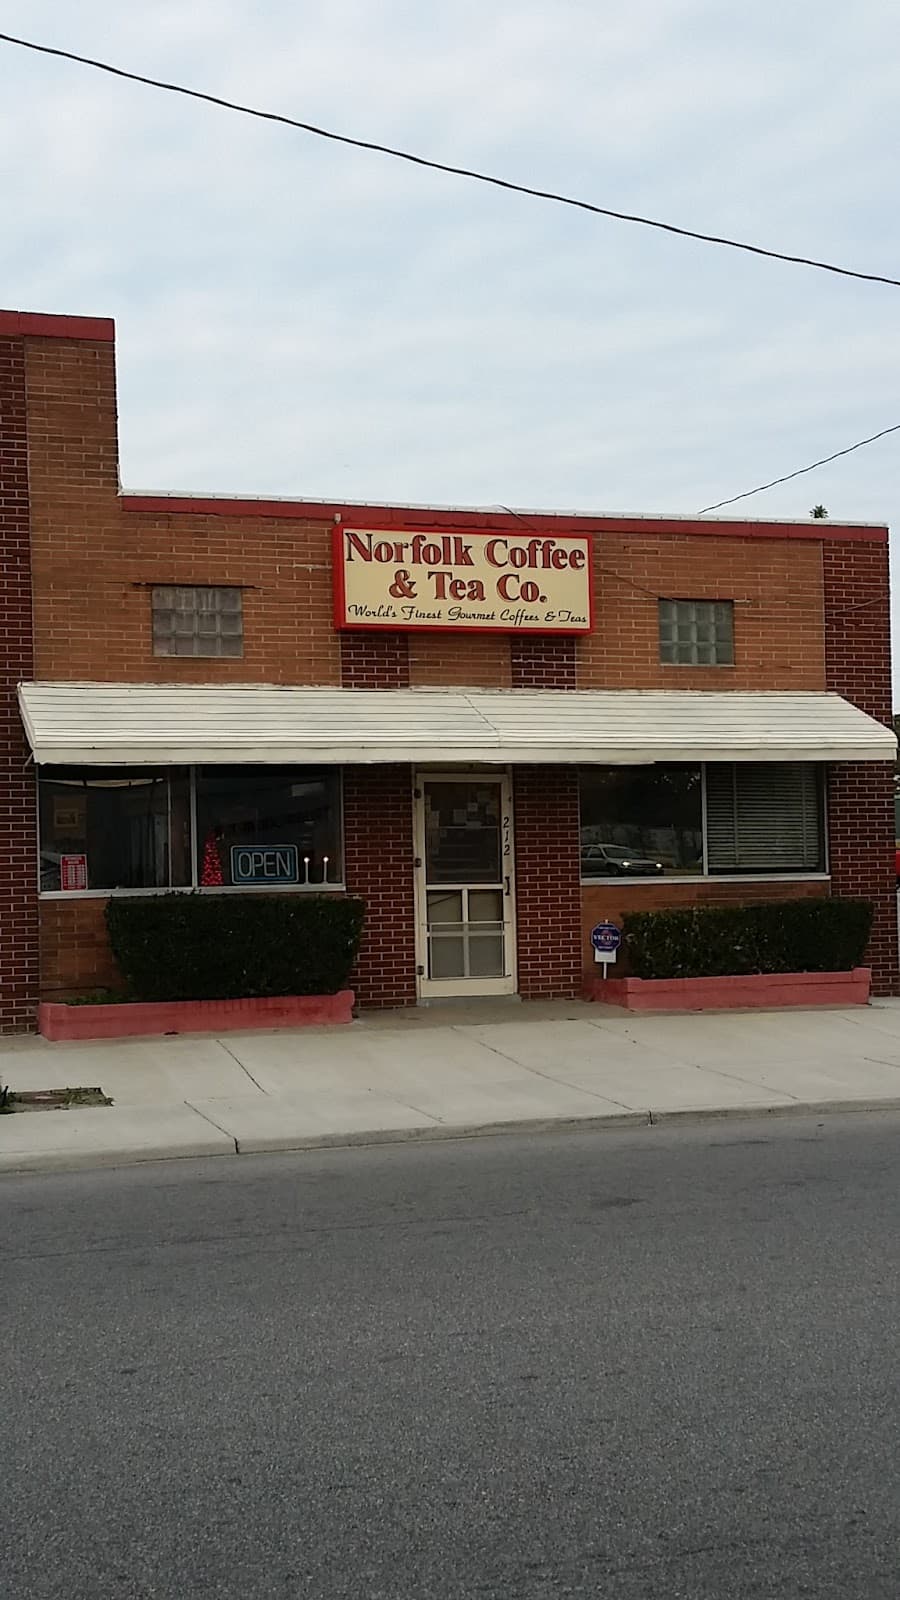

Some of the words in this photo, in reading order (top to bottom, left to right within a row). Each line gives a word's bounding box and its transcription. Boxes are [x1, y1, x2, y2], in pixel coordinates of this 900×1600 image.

[345, 532, 475, 567] Norfolk
[484, 538, 586, 570] Coffee
[389, 569, 418, 599] &
[427, 571, 486, 601] Tea
[496, 573, 548, 603] Co.
[348, 604, 397, 618] World's
[401, 606, 442, 621] Finest
[447, 606, 496, 621] Gourmet
[500, 608, 540, 626] Coffees
[544, 611, 556, 622] &
[558, 610, 587, 623] Teas
[238, 851, 291, 878] OPEN
